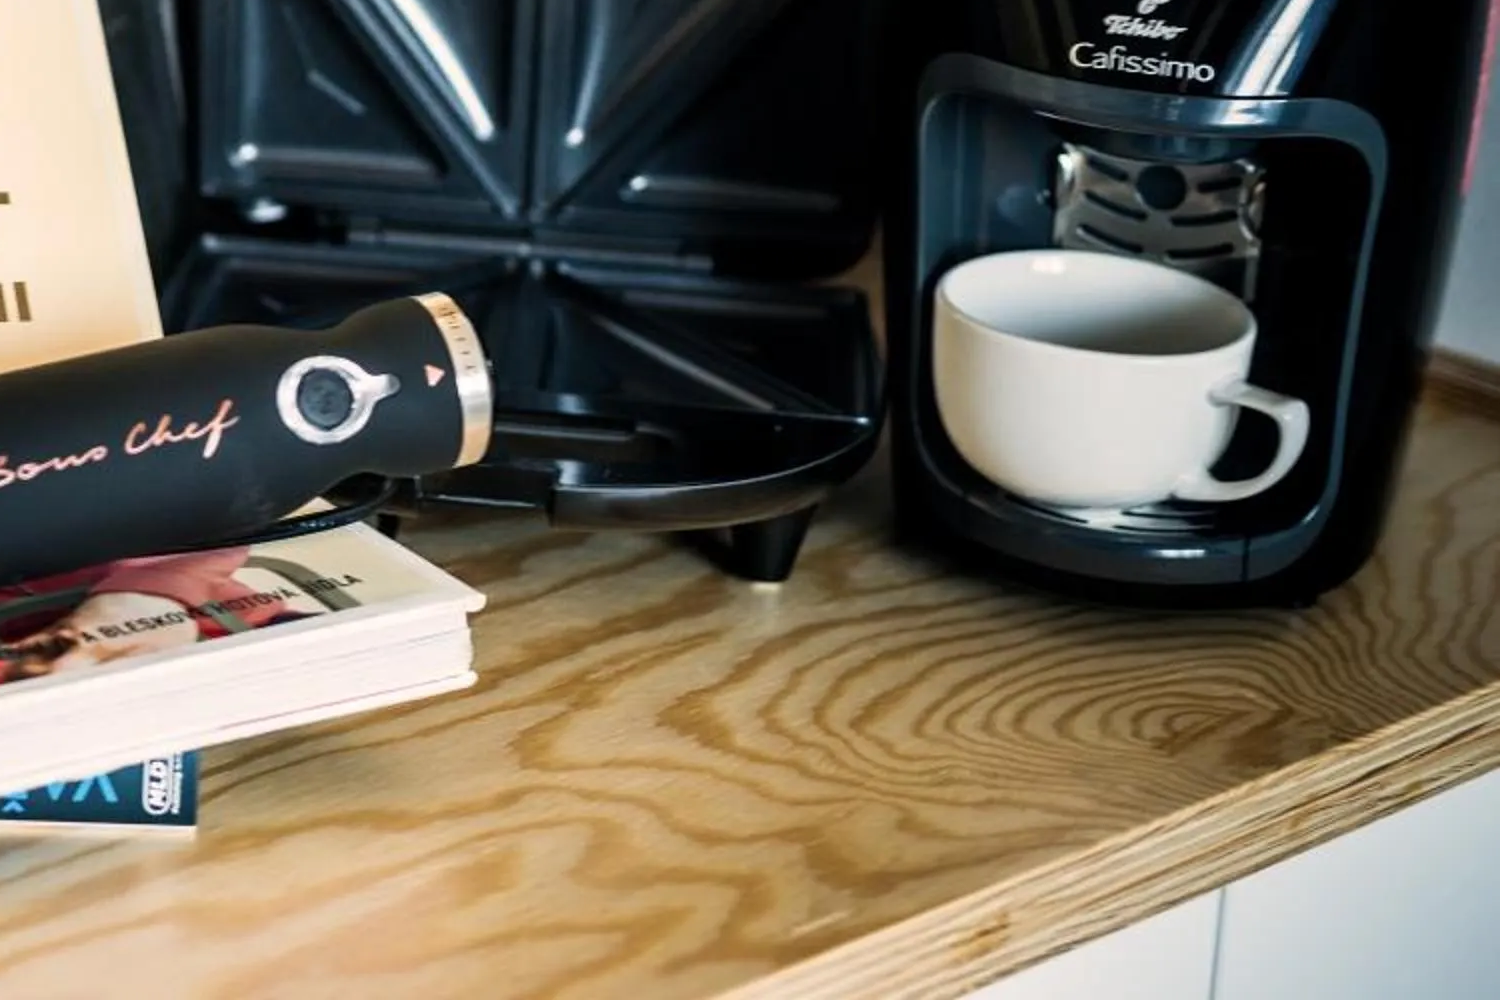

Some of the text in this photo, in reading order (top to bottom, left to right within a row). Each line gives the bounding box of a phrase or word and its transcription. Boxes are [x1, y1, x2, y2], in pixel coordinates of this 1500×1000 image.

[1102, 13, 1189, 40] Tchibo
[1068, 41, 1216, 83] Cafissimo
[123, 398, 242, 460] Chef
